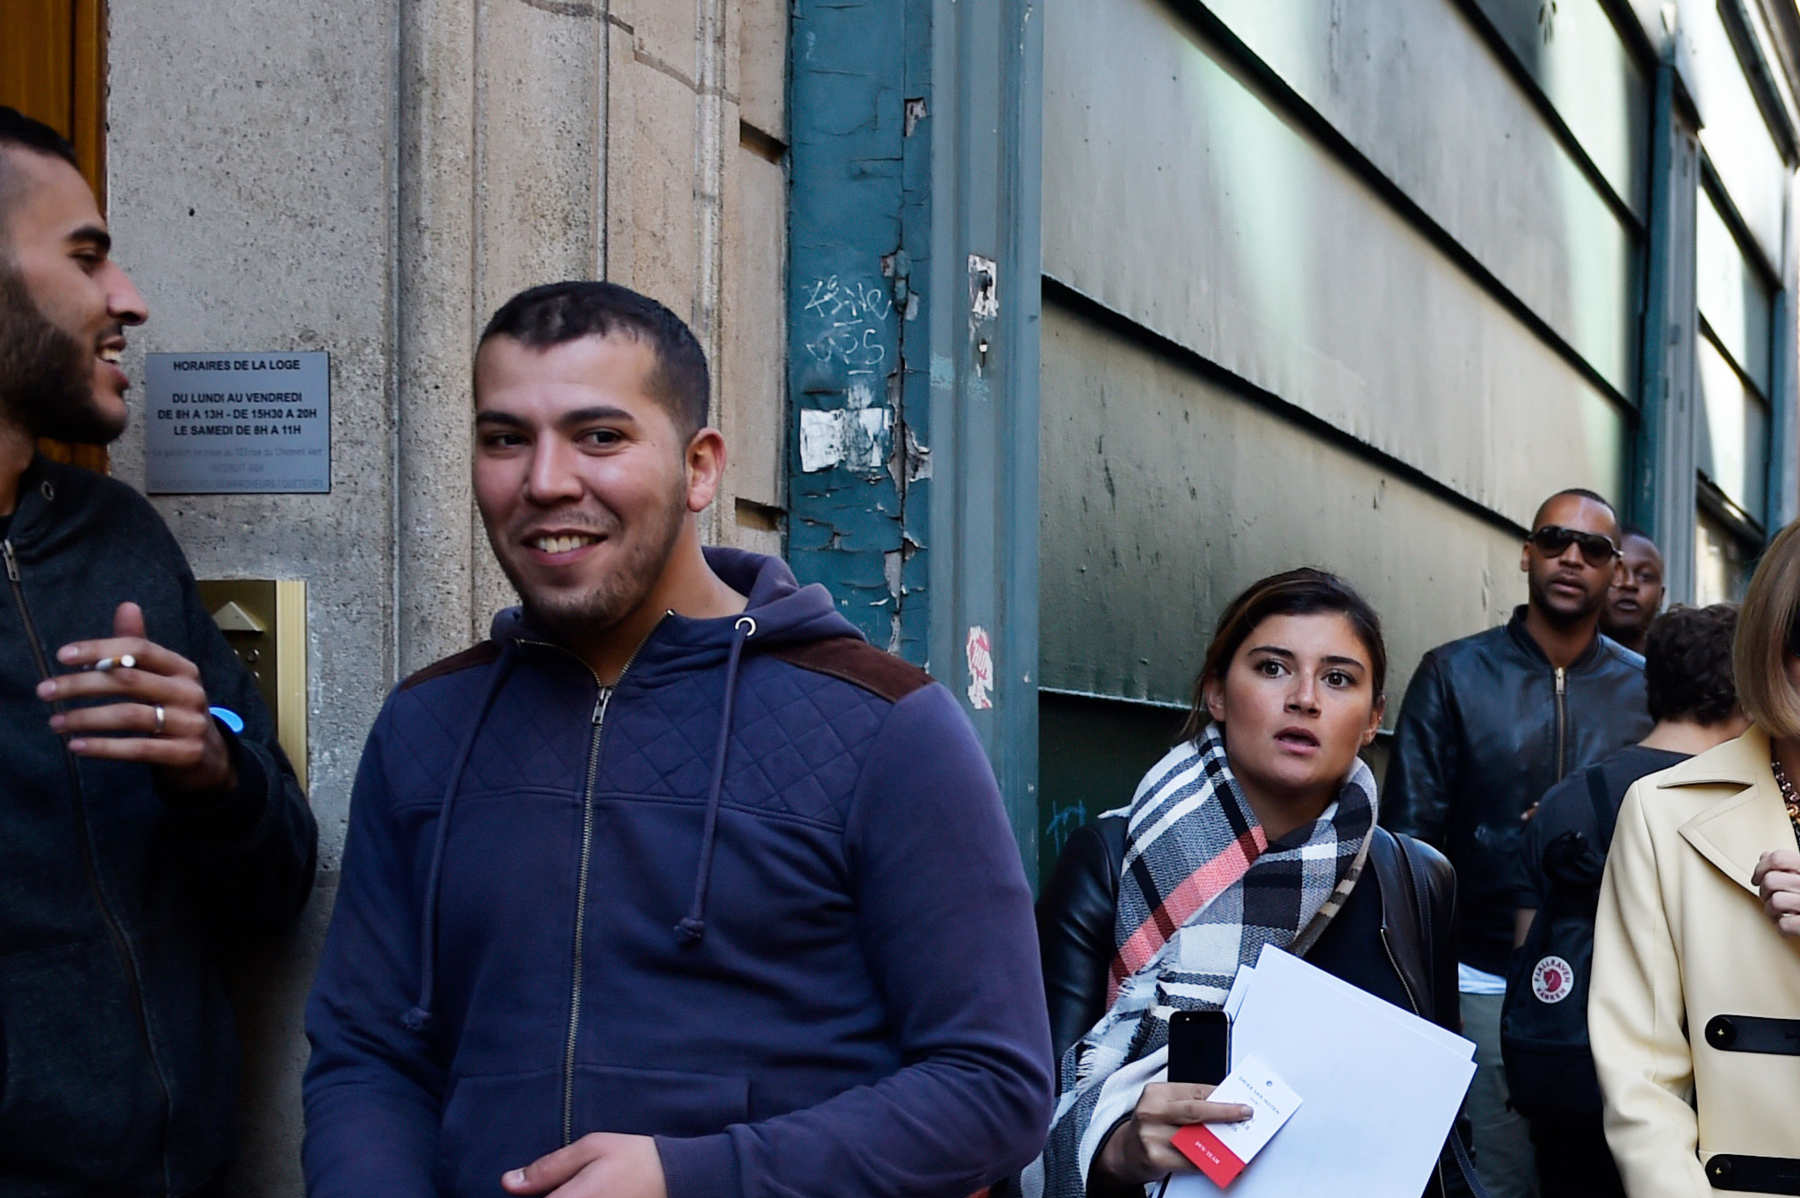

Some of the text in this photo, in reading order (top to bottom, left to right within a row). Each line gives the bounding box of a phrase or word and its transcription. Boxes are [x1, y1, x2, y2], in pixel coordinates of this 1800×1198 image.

[173, 359, 301, 371] HORAIRES DE LA LOGE
[172, 392, 302, 403] DU LUNDI AU VENDREDI
[157, 409, 173, 420] DE
[192, 409, 201, 419] A
[204, 409, 223, 419] 13H
[233, 409, 248, 419] DE
[252, 409, 283, 419] 15H30
[285, 409, 294, 418] A
[297, 408, 317, 418] 20H
[173, 426, 187, 436] LE
[191, 425, 233, 436] SAMEDI
[235, 425, 251, 435] DE
[270, 425, 279, 435] A
[282, 425, 301, 435] 11H
